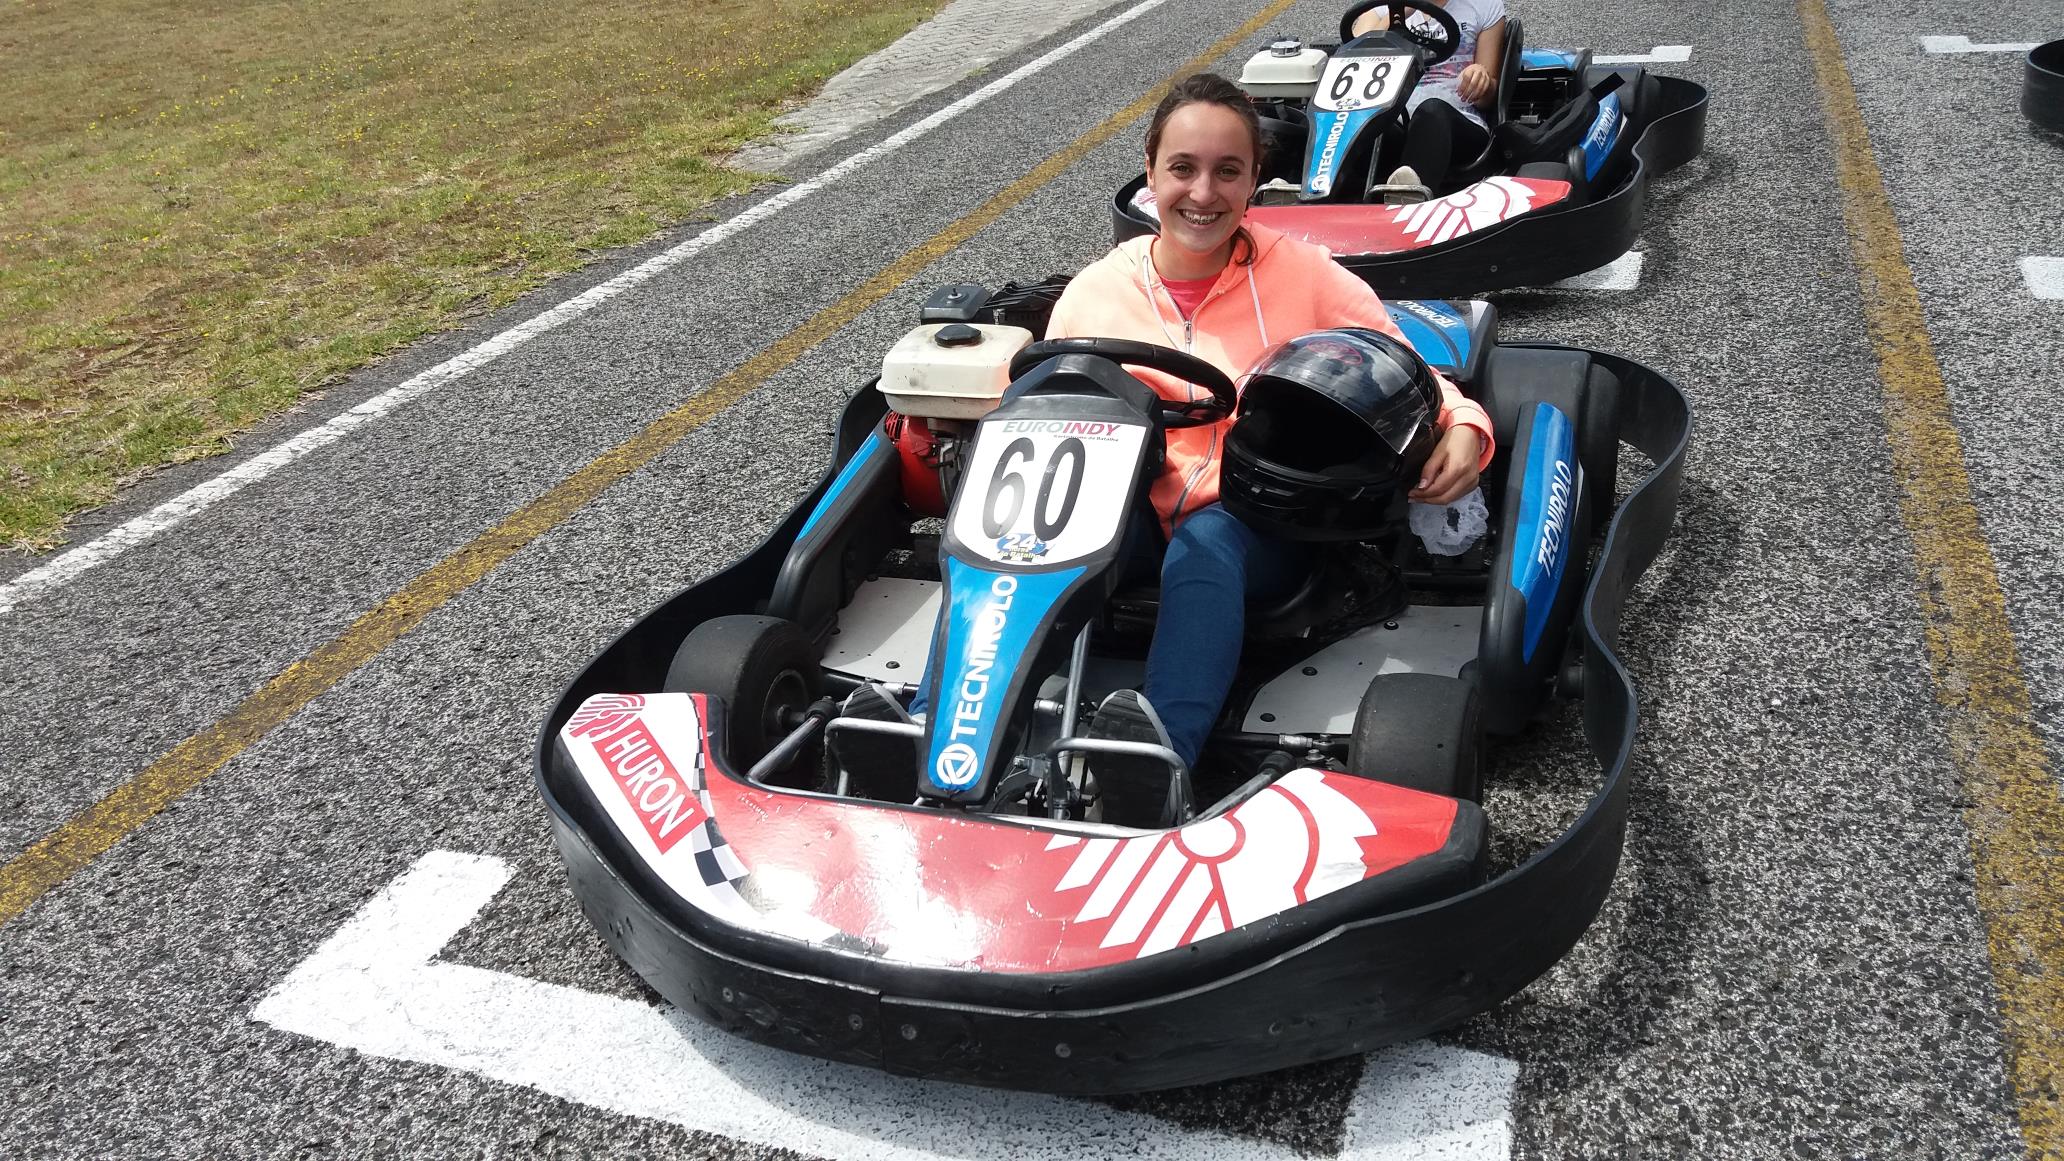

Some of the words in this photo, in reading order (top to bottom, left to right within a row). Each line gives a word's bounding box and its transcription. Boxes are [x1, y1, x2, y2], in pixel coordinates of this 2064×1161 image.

[1330, 62, 1391, 101] 68
[1317, 112, 1349, 178] TECNIROLO
[1002, 421, 1121, 436] EUROINDY
[982, 437, 1086, 541] 60
[1538, 460, 1573, 577] TECNIROLO
[1002, 533, 1037, 551] 24
[951, 576, 1018, 740] TECNIROLO
[604, 729, 695, 839] HURON
